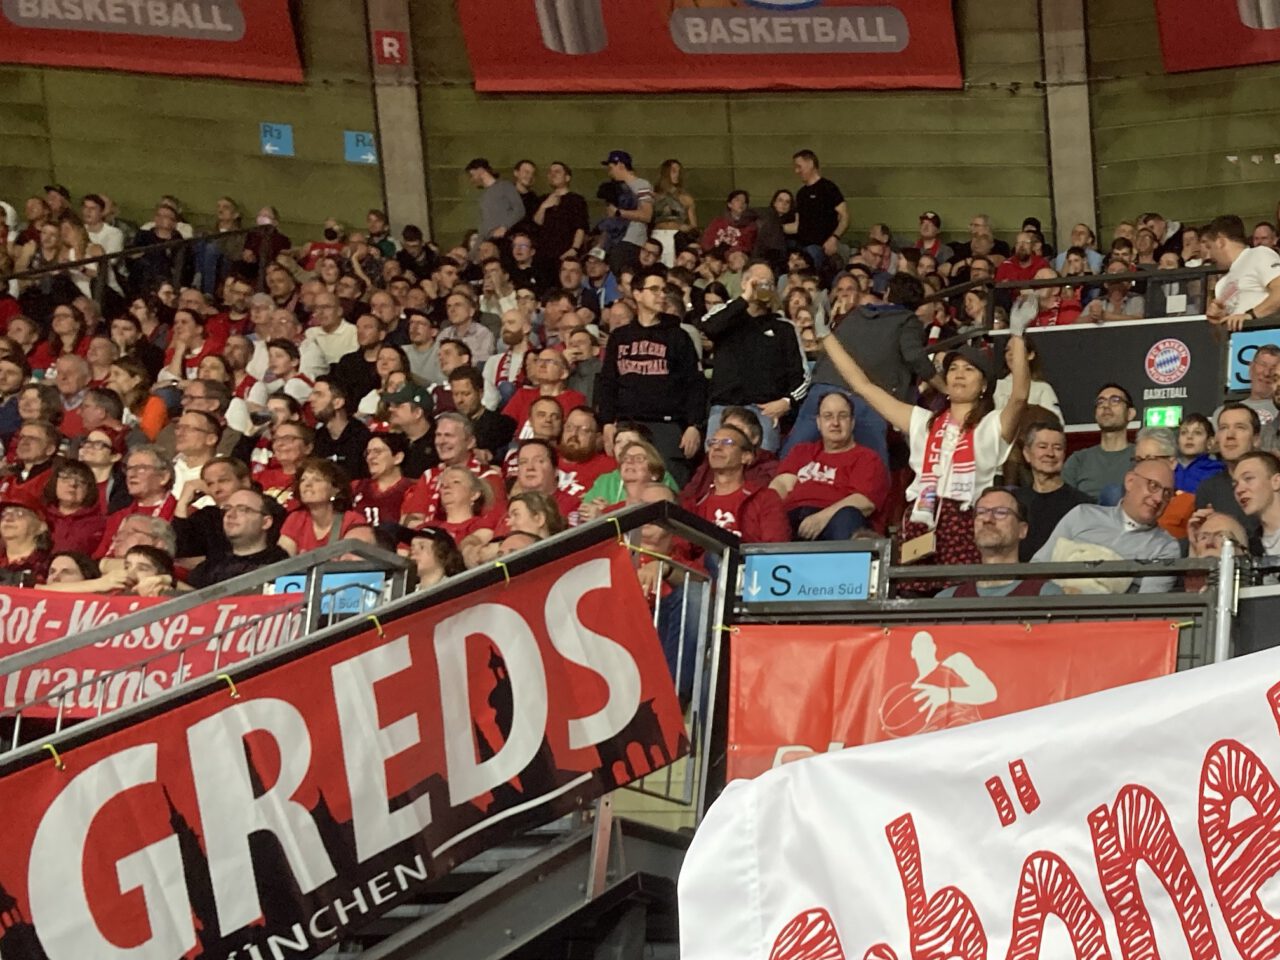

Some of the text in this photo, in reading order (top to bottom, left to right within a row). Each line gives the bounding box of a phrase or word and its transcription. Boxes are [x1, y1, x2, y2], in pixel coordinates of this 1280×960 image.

[18, 0, 233, 32] BASKETBALL
[685, 16, 897, 44] BASKETBALL
[382, 36, 401, 58] R
[262, 124, 283, 140] R3
[770, 564, 863, 597] S Arena Süd
